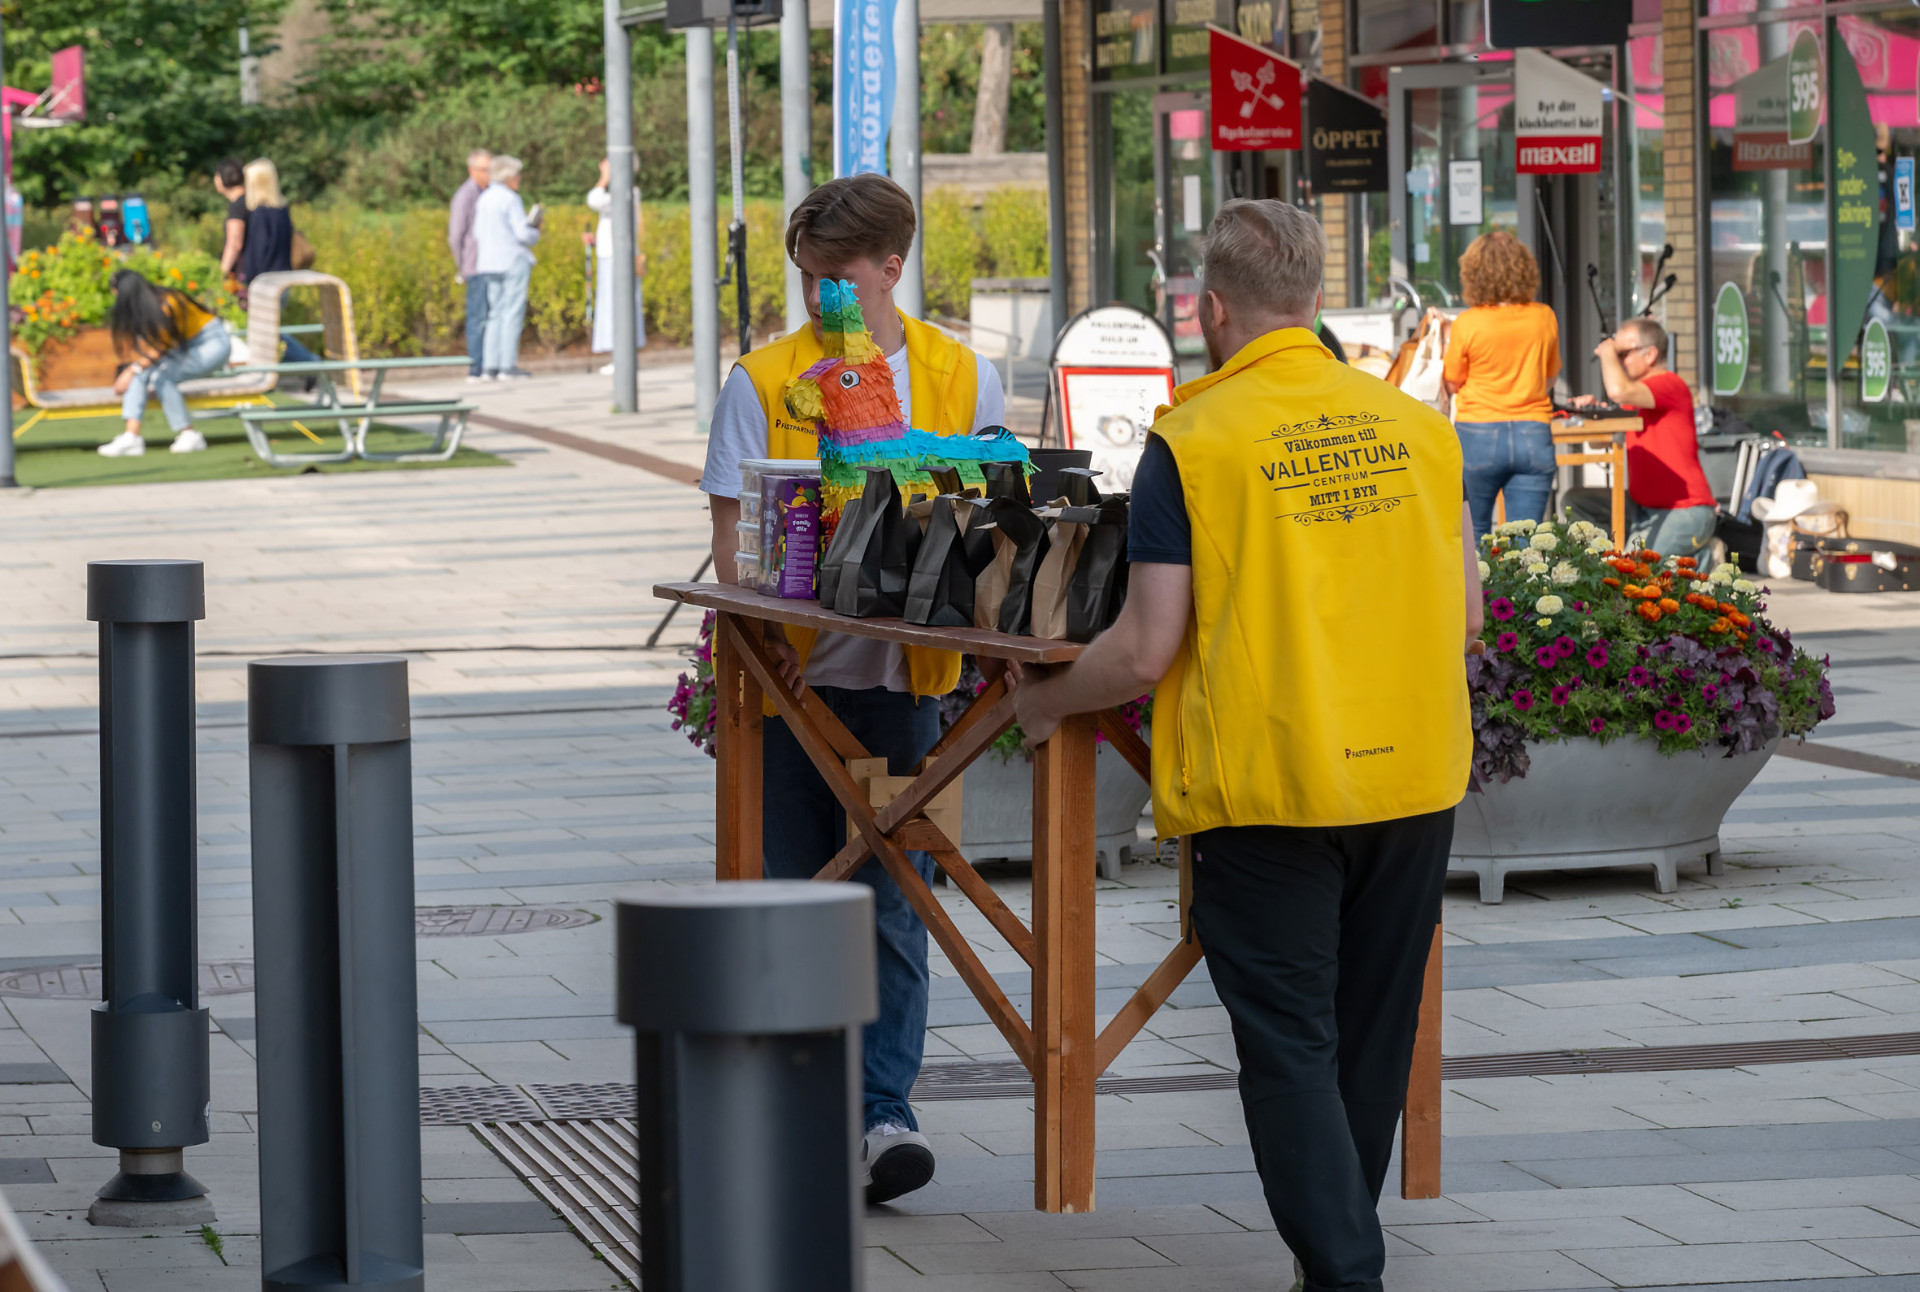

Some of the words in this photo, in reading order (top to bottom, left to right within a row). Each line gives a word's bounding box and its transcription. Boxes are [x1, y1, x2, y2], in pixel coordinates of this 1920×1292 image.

[1792, 72, 1818, 112] 395
[1538, 101, 1555, 115] Byt
[1558, 101, 1576, 112] ditt
[1313, 127, 1382, 150] ÖPPET
[1520, 142, 1596, 166] maxell
[1717, 327, 1743, 365] 395
[1866, 351, 1886, 377] 395
[1284, 430, 1356, 453] Välkommen
[1358, 428, 1377, 441] till
[1260, 442, 1411, 482] VALLENTUNA
[1313, 470, 1369, 487] CENTRUM
[1309, 490, 1340, 507] MITT
[1344, 489, 1350, 501] I
[1353, 484, 1378, 499] BYN
[792, 519, 811, 528] Family
